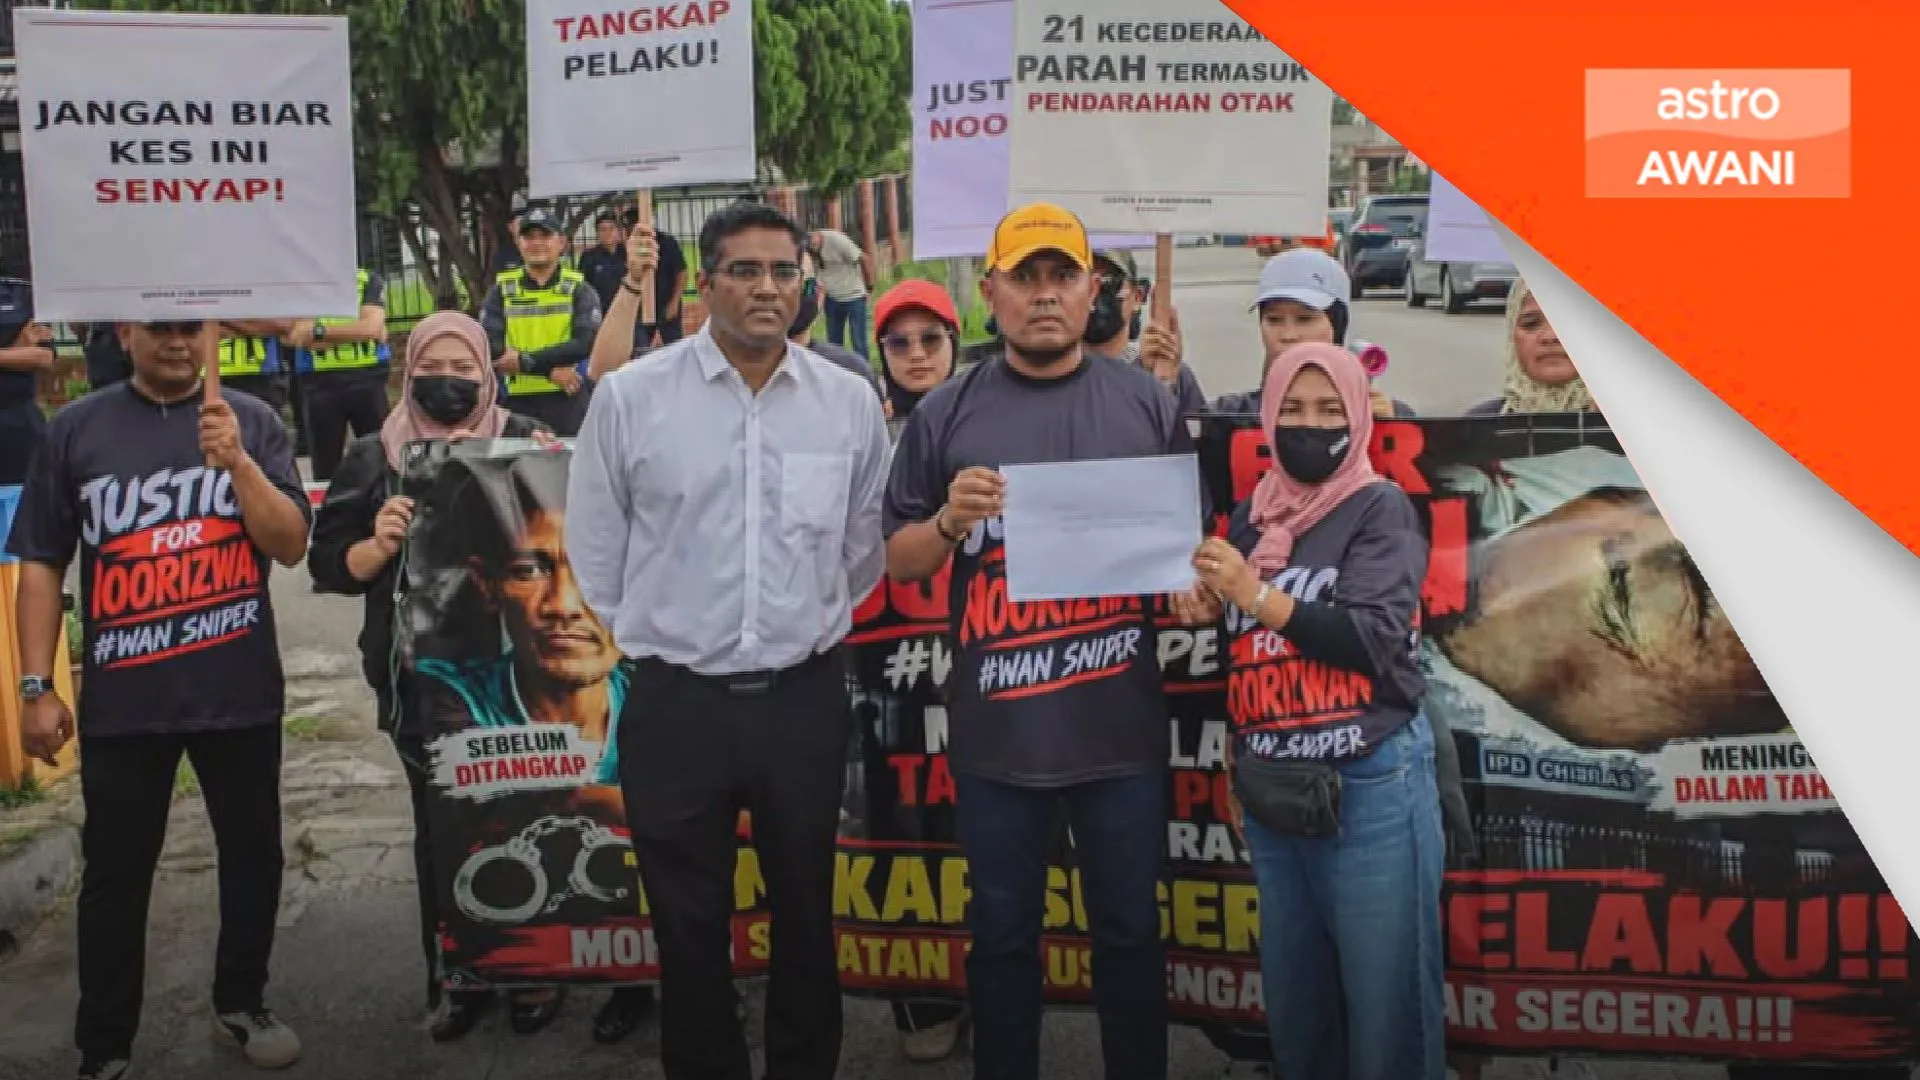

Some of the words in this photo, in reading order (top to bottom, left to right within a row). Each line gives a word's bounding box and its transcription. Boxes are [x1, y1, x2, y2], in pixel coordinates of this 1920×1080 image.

[553, 0, 731, 43] TANGKAP
[1043, 14, 1085, 43] 21
[1098, 22, 1269, 43] KECEDERAA
[564, 39, 719, 80] PELAKU!
[1016, 54, 1147, 84] PARAH
[1156, 61, 1310, 84] TERMASUK
[927, 77, 1012, 112] JUST
[1027, 91, 1211, 114] PENDARAHAN
[1220, 91, 1294, 114] OTAK
[34, 99, 214, 130] JANGAN
[231, 101, 332, 127] BIAR
[110, 139, 193, 165] KES
[211, 139, 269, 165] INI
[95, 177, 286, 204] SENYAP!
[79, 465, 239, 546] JUSTIC
[152, 522, 204, 554] FOR
[90, 539, 261, 620] OORIZWA
[93, 619, 174, 666] #WAN
[179, 600, 260, 645] SNIPER
[978, 646, 1054, 694] #WAN
[1059, 626, 1143, 680] SNIPER
[466, 731, 568, 759] SEBELUM
[1701, 741, 1815, 771] MENING
[455, 754, 586, 788] DITANGKAP
[1675, 774, 1768, 803] DALAM
[1444, 892, 1909, 981] ELAKU!!
[1515, 988, 1794, 1042] SEGERA!!!
